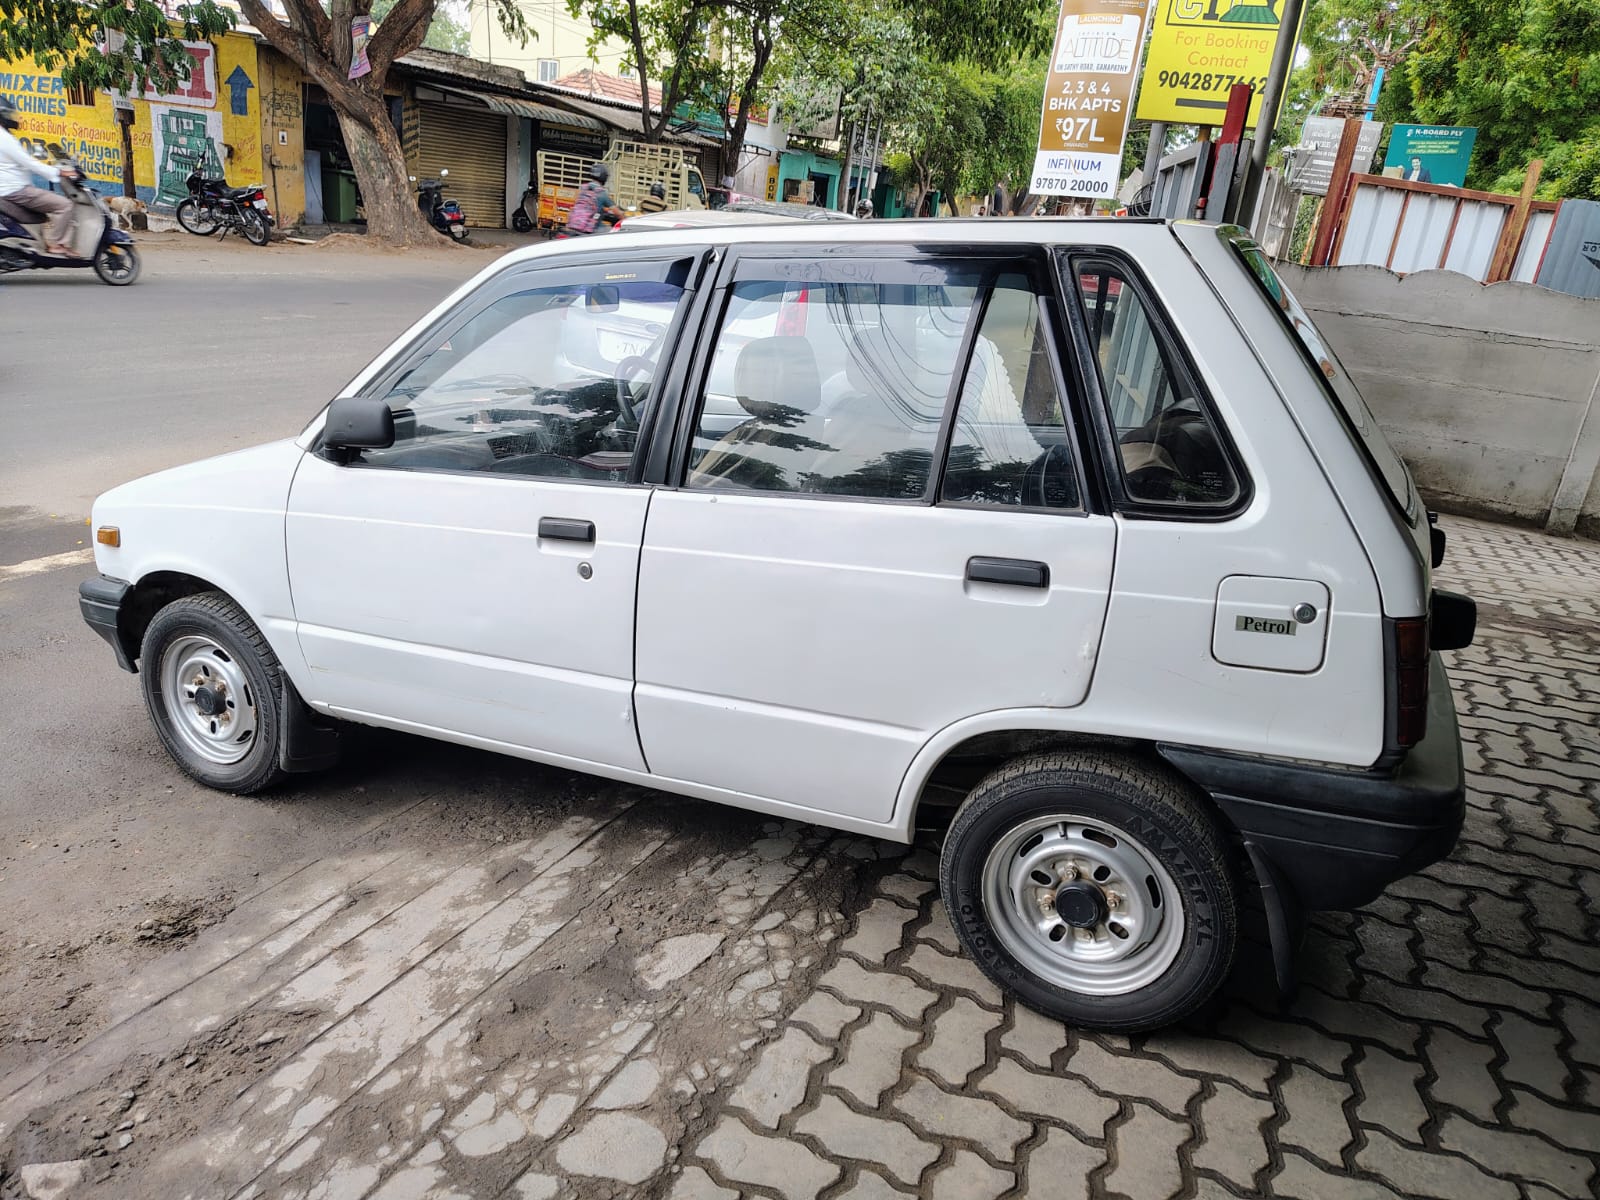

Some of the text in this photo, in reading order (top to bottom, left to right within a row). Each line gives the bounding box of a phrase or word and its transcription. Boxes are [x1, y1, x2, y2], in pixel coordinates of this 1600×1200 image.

[1175, 31, 1270, 54] For Booking
[1187, 51, 1249, 69] Contact
[0, 72, 63, 95] MIXER
[1062, 81, 1111, 95] 2, 3 & 4
[1049, 97, 1122, 113] BHK APTS
[30, 118, 45, 131] Gas
[60, 137, 120, 161] Sri Ayyan
[1047, 157, 1102, 172] INFINIUM
[1035, 178, 1109, 193] 97870 20000
[1242, 616, 1292, 635] Petrol
